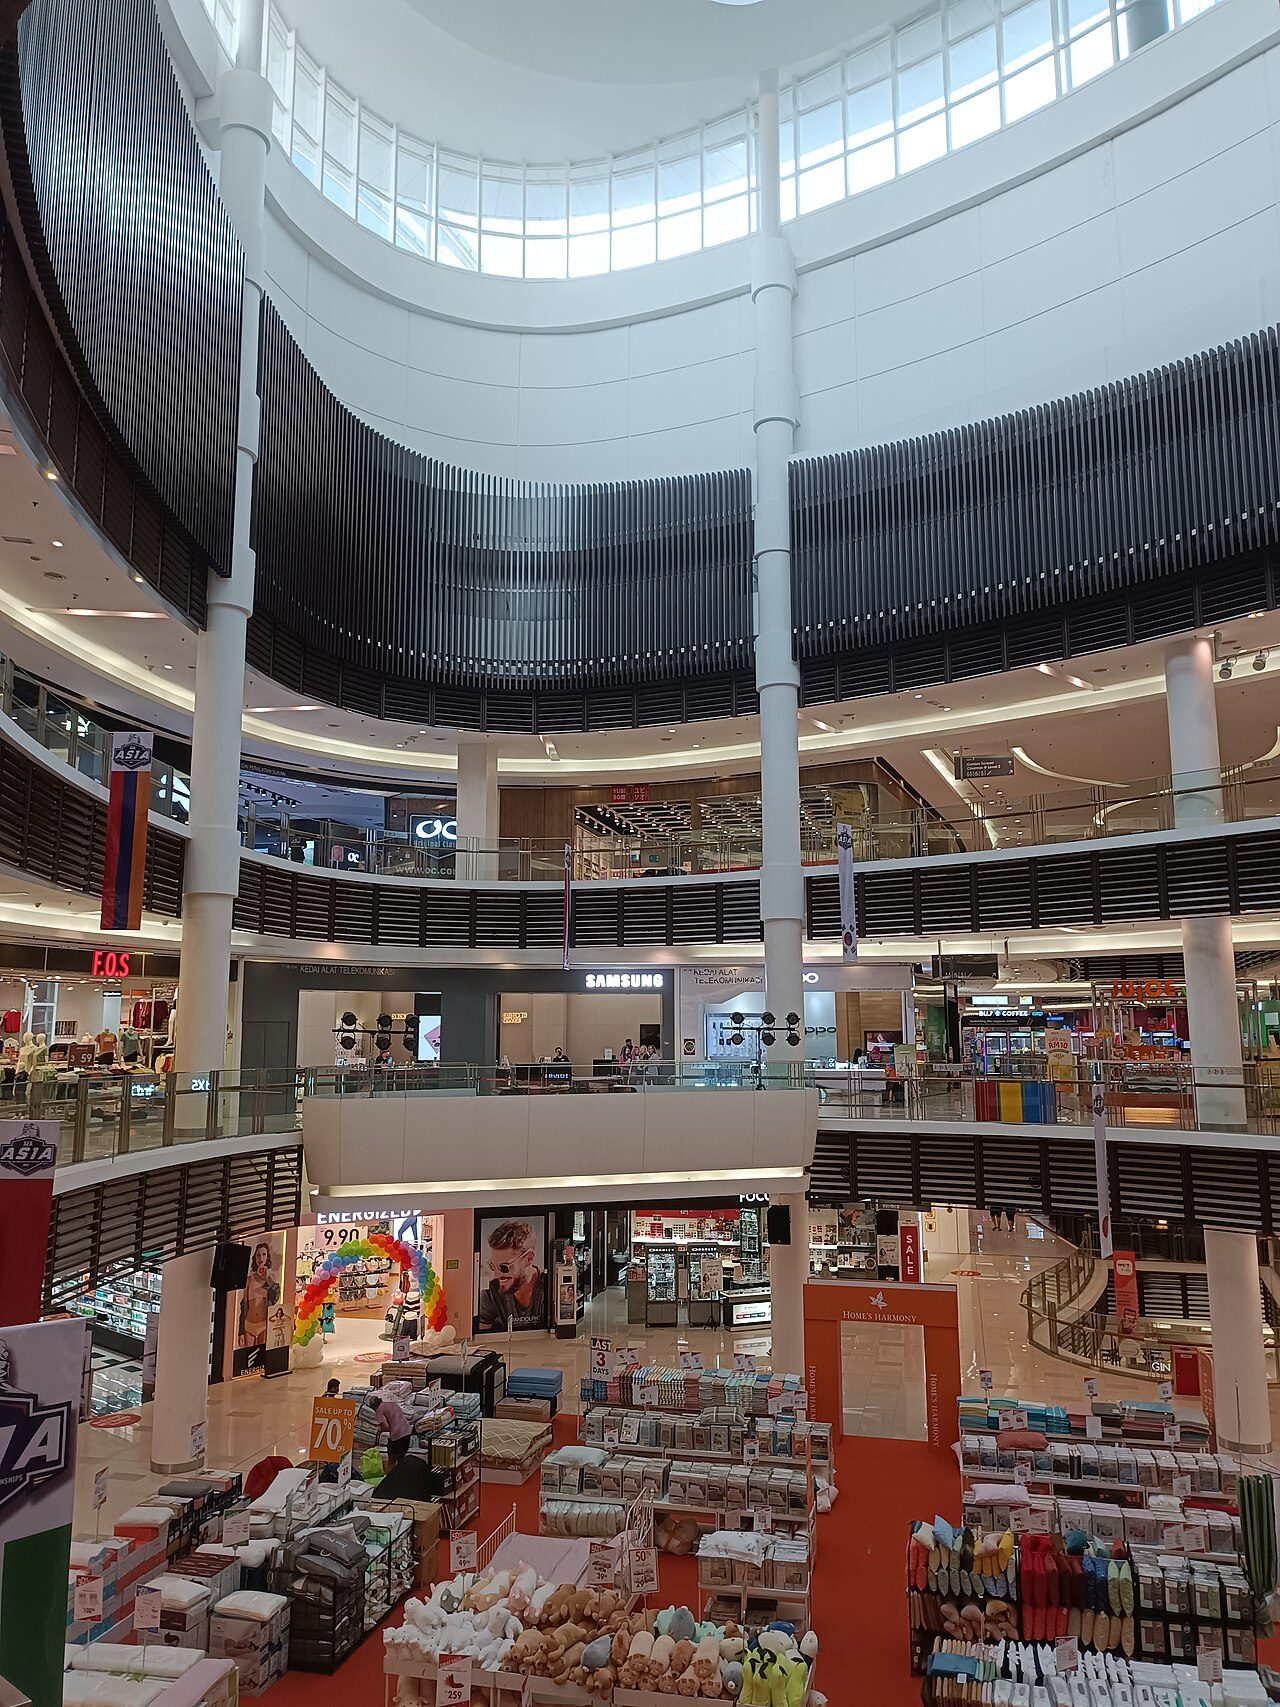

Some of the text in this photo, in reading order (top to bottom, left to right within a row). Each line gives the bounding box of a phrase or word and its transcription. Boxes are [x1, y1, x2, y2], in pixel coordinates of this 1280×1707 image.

[115, 750, 149, 759] ASIA
[396, 865, 456, 876] www.oc.co
[92, 950, 130, 977] F.O.S
[300, 964, 320, 974] KEDAI
[320, 965, 338, 975] ALAT
[717, 968, 738, 976] ALAT
[585, 973, 664, 988] SAMSUNG
[1111, 980, 1176, 1002] JUICE
[804, 1027, 837, 1035] ppo
[80, 1053, 92, 1063] 59
[0, 1147, 52, 1160] ASIA
[905, 1235, 914, 1275] SALE
[511, 1315, 540, 1323] ANDOLPH
[874, 1313, 917, 1323] HARMONY
[592, 1340, 612, 1351] LAST
[595, 1351, 606, 1367] 3
[240, 1364, 265, 1376] ENERGIZ
[592, 1366, 610, 1375] DAYS
[315, 1406, 333, 1415] SALE
[931, 1407, 940, 1448] HARMONY
[0, 1474, 23, 1485] NSHIPS
[447, 1690, 462, 1700] 259
